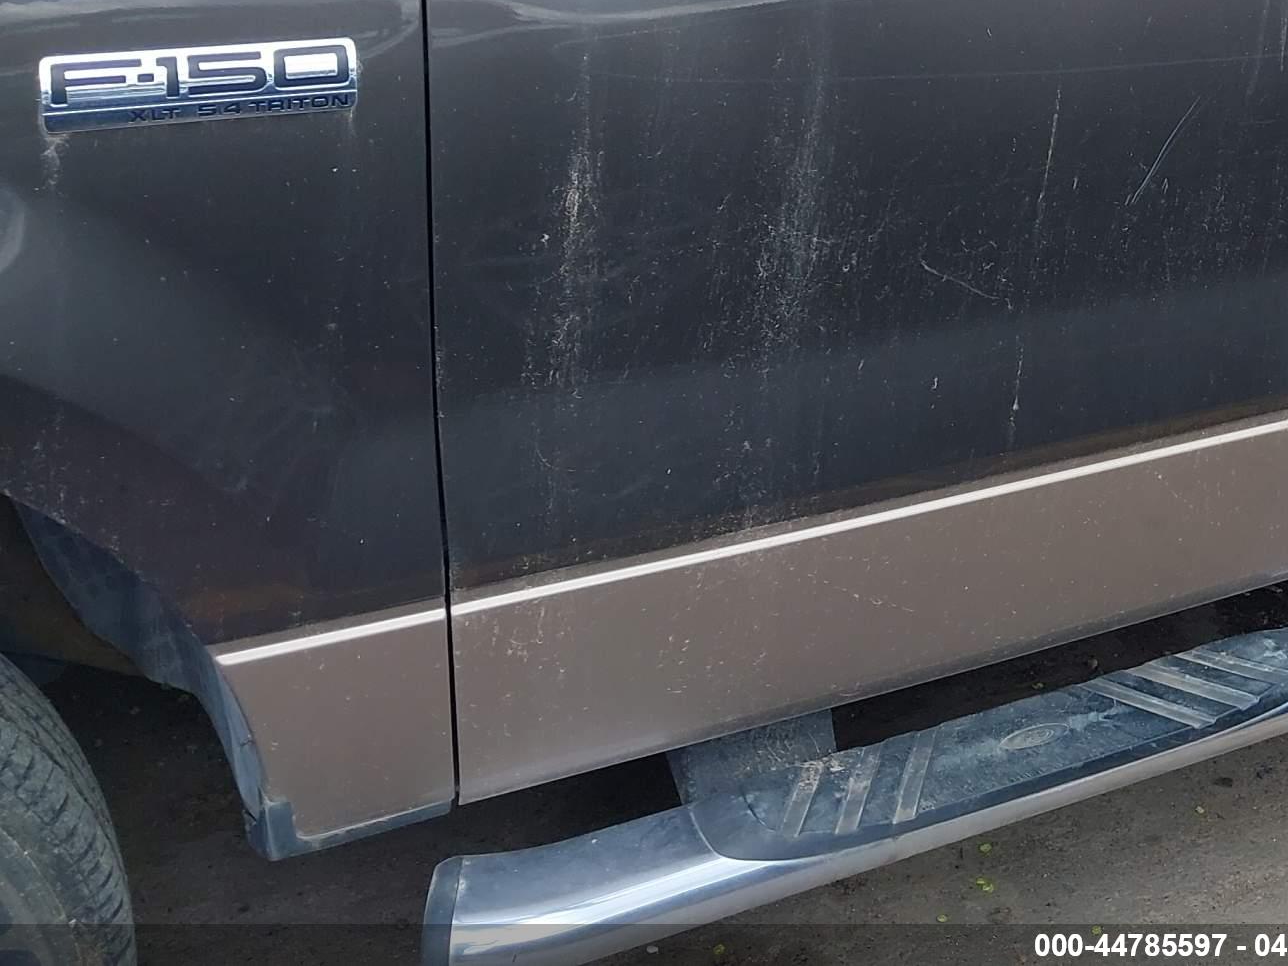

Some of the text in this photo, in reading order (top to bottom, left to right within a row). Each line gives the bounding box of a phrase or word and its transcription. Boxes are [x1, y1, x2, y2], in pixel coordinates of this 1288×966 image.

[50, 44, 350, 107] F-150
[128, 106, 181, 123] XLT
[248, 93, 349, 114] TRITON
